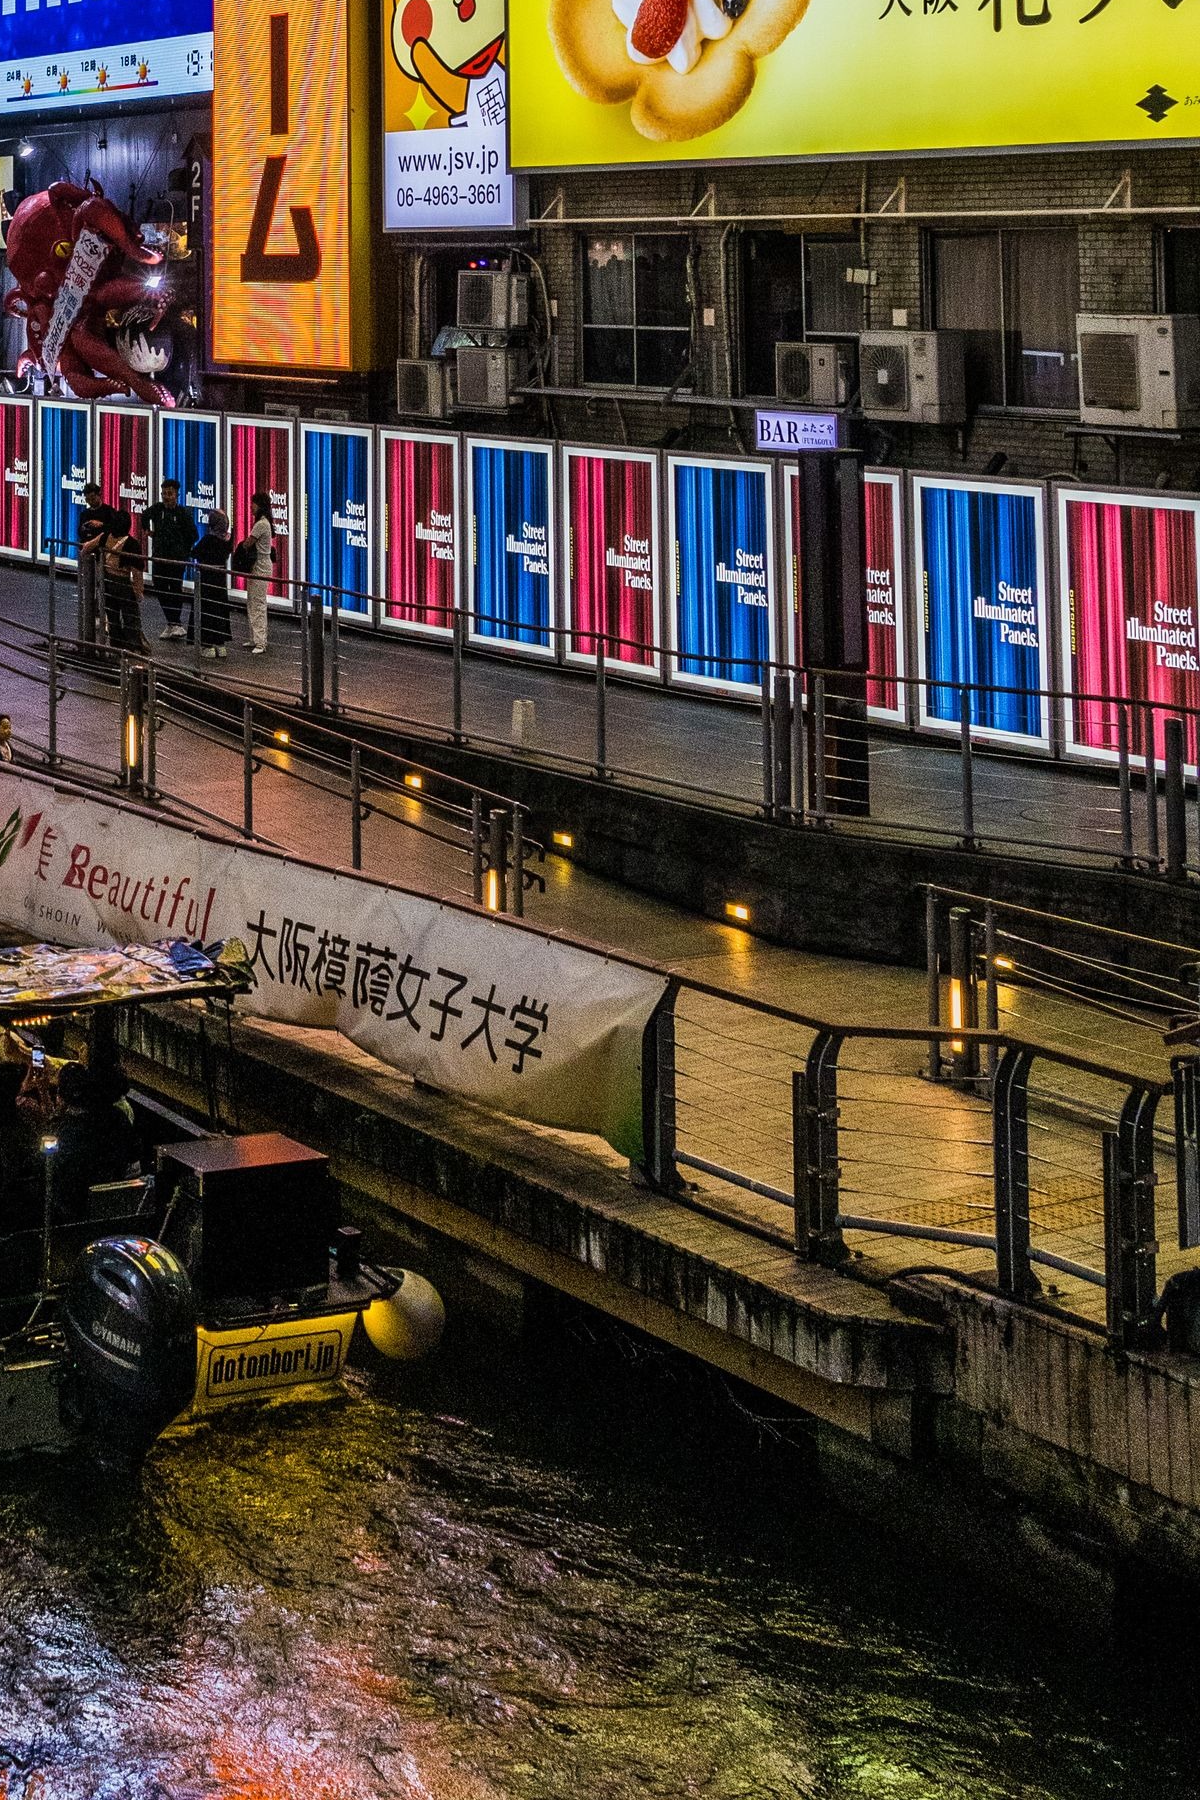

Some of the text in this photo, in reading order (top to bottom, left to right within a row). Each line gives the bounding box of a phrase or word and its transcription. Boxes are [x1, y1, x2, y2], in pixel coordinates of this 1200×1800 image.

[398, 144, 499, 176] www.jsv.jp
[396, 184, 501, 207] 06-4963-3661
[759, 419, 800, 444] BAR
[802, 423, 834, 434] ふたごや
[131, 472, 147, 487] Street
[197, 480, 214, 497] Street
[346, 499, 365, 517] Street
[430, 509, 452, 527] Street
[347, 530, 368, 548] Panels.
[522, 521, 546, 540] Street
[431, 542, 455, 561] Panels.
[623, 534, 649, 555] Street
[523, 555, 549, 575] Panels.
[735, 548, 764, 568] Street
[625, 570, 653, 591] Panels.
[866, 567, 890, 586] treet
[737, 585, 768, 608] Panels.
[866, 587, 893, 605] nated
[998, 580, 1033, 605] Street
[867, 606, 896, 626] anels.
[1154, 600, 1193, 626] Street
[1000, 622, 1039, 648] Panels.
[1156, 645, 1200, 671] Panels.
[62, 843, 216, 942] Beautiful
[39, 905, 82, 927] SHOIN
[101, 1326, 142, 1357] YAMAHA
[212, 1341, 334, 1384] dotonbori.jp
